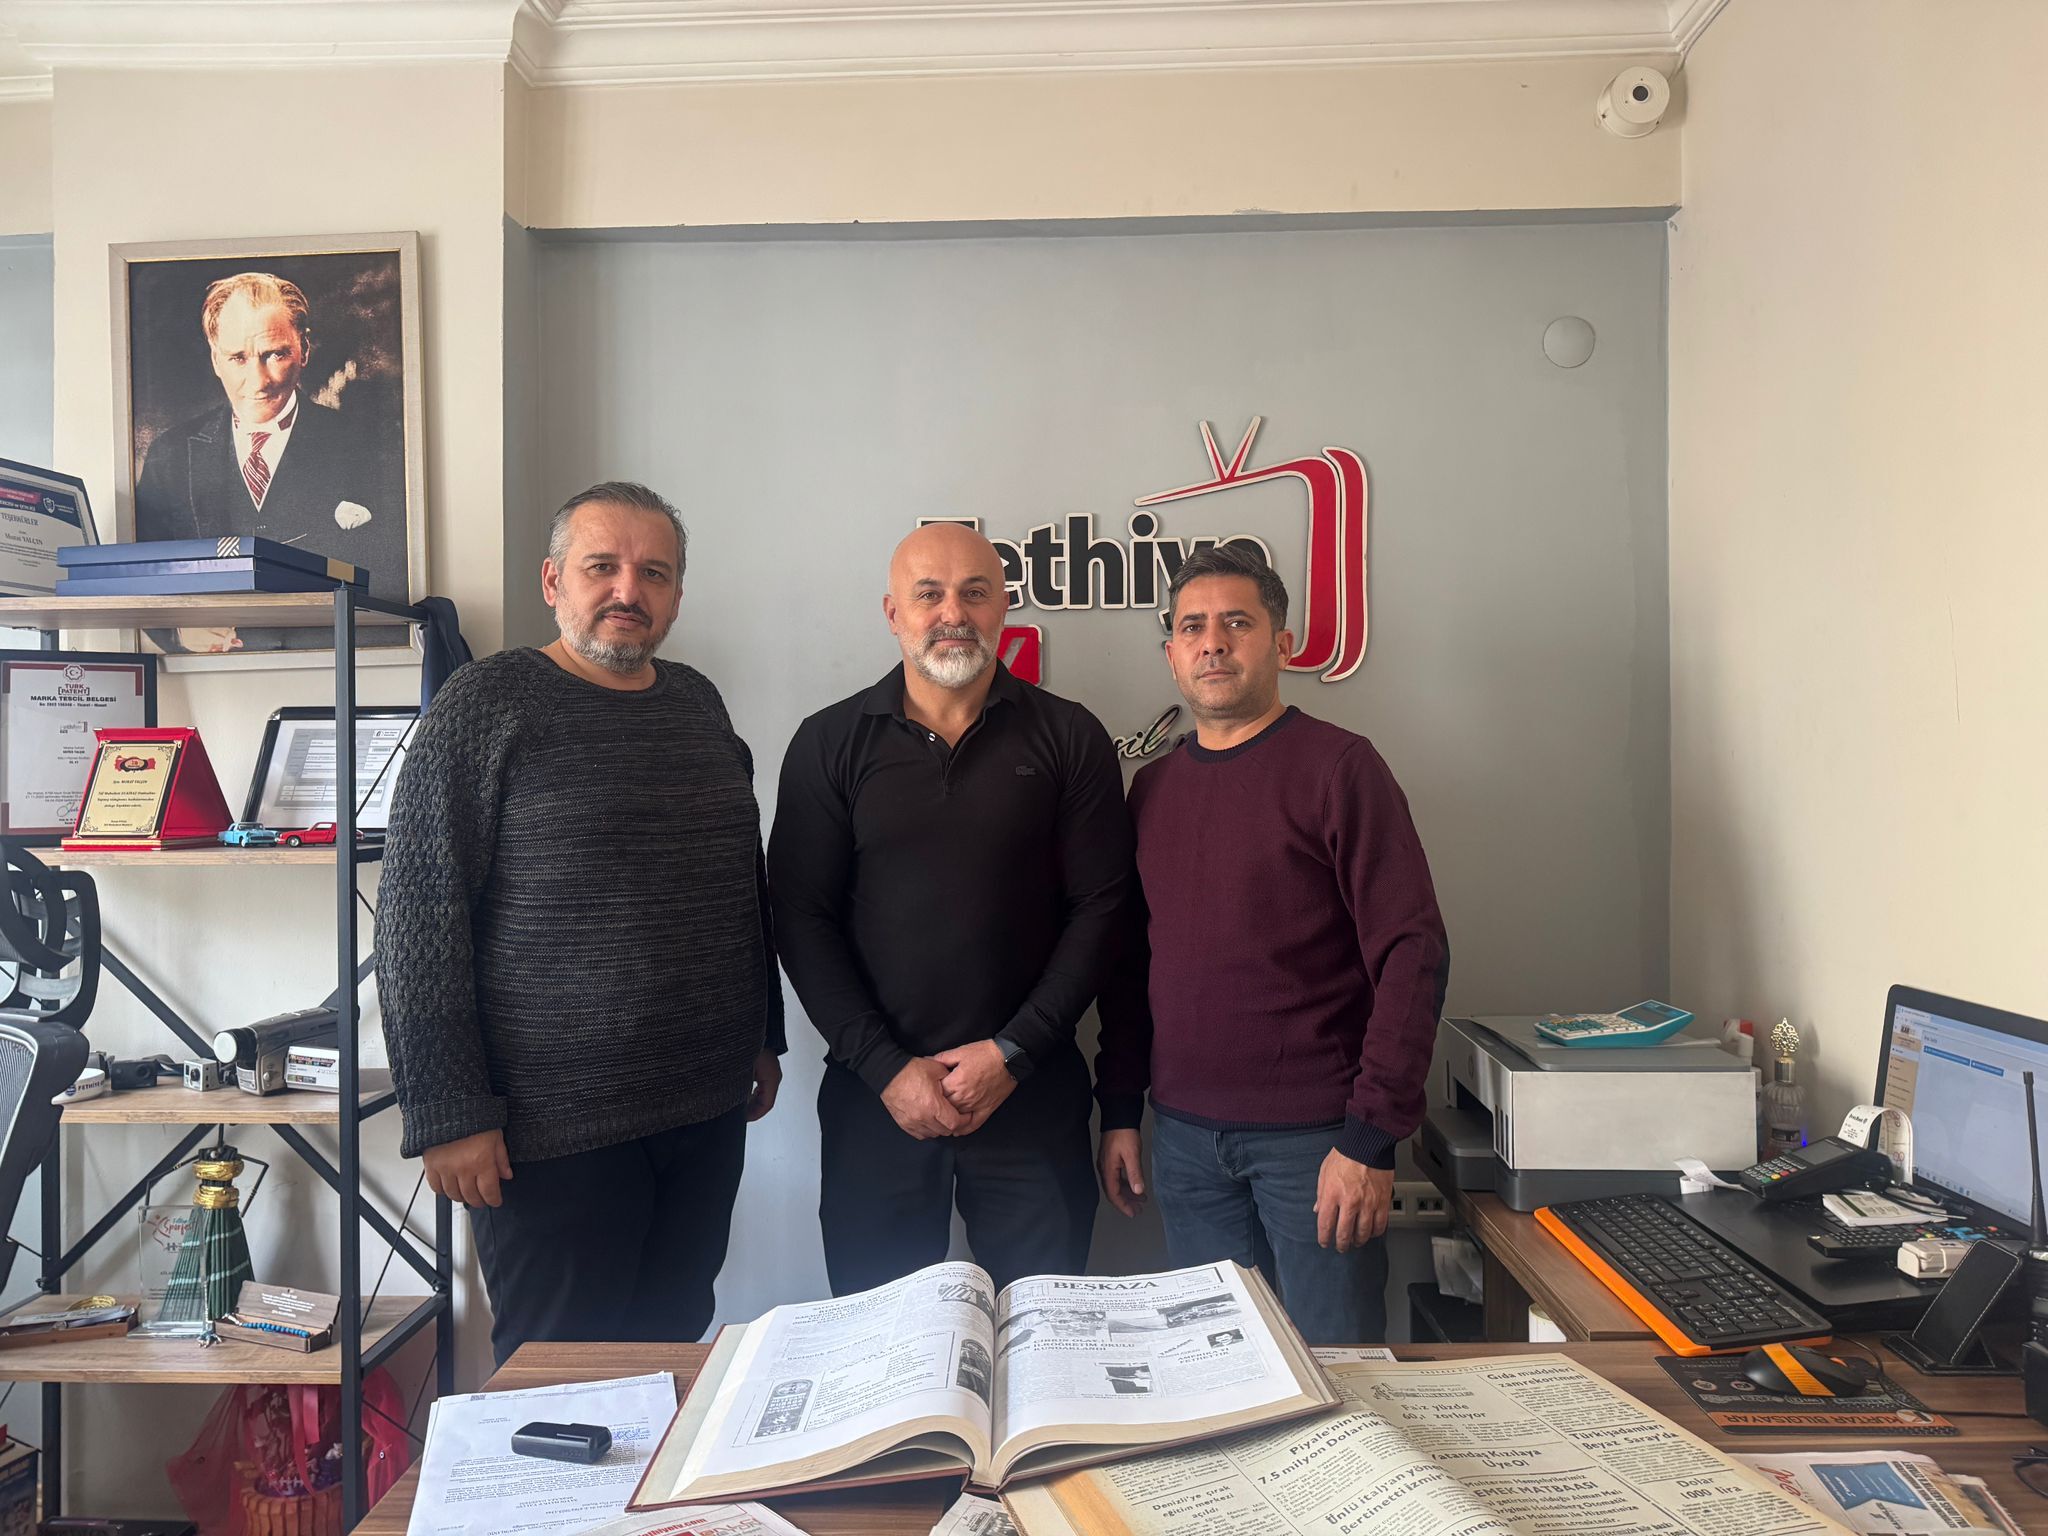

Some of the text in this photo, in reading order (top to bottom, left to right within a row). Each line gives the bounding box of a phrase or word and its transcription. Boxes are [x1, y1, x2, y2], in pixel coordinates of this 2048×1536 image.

[1257, 1471, 1281, 1485] 7.5
[1281, 1446, 1327, 1475] milyon
[1676, 1477, 1714, 1487] Dolar
[1475, 1482, 1598, 1498] EMEK MATBAASI
[1680, 1485, 1742, 1499] 1000 lira
